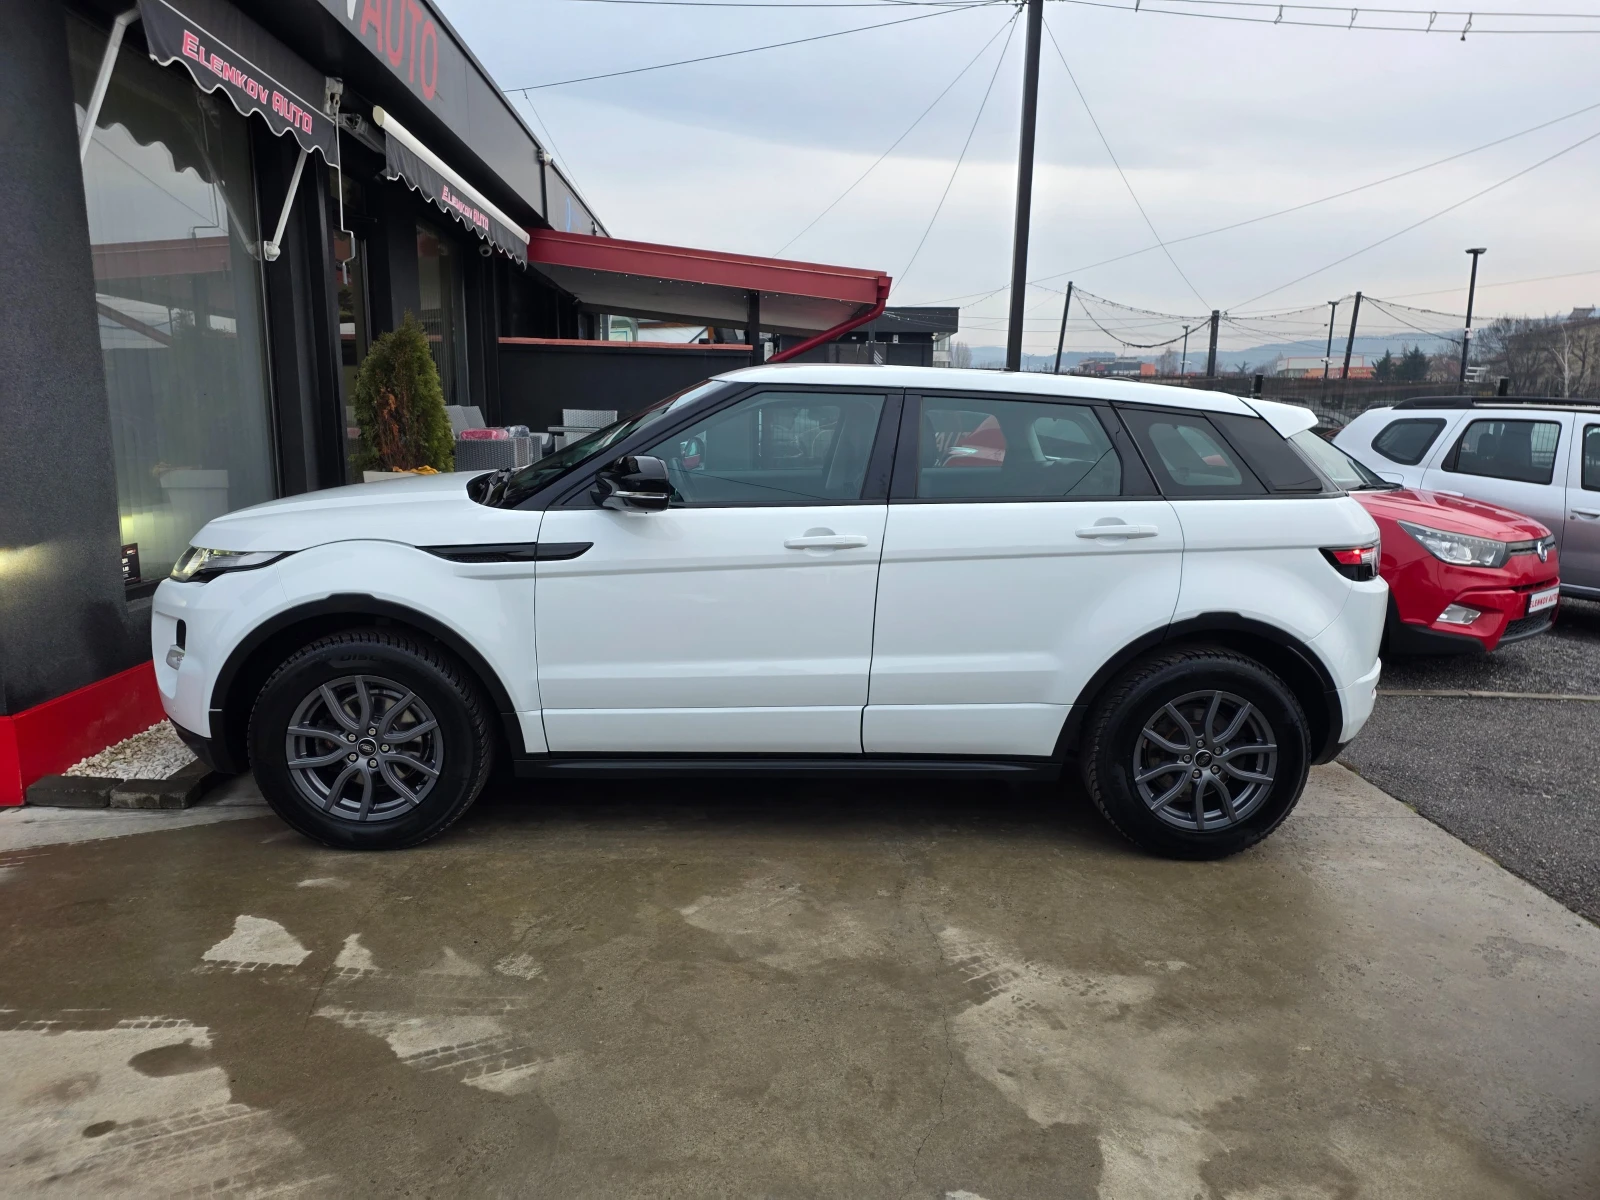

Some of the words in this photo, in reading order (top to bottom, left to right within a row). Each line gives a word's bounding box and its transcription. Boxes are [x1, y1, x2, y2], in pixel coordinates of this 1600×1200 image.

[182, 29, 269, 105] ELENKOV
[272, 90, 313, 135] AUTO
[361, 0, 438, 101] AUTO
[441, 184, 473, 220] ELENKOV
[473, 208, 489, 231] AUTO
